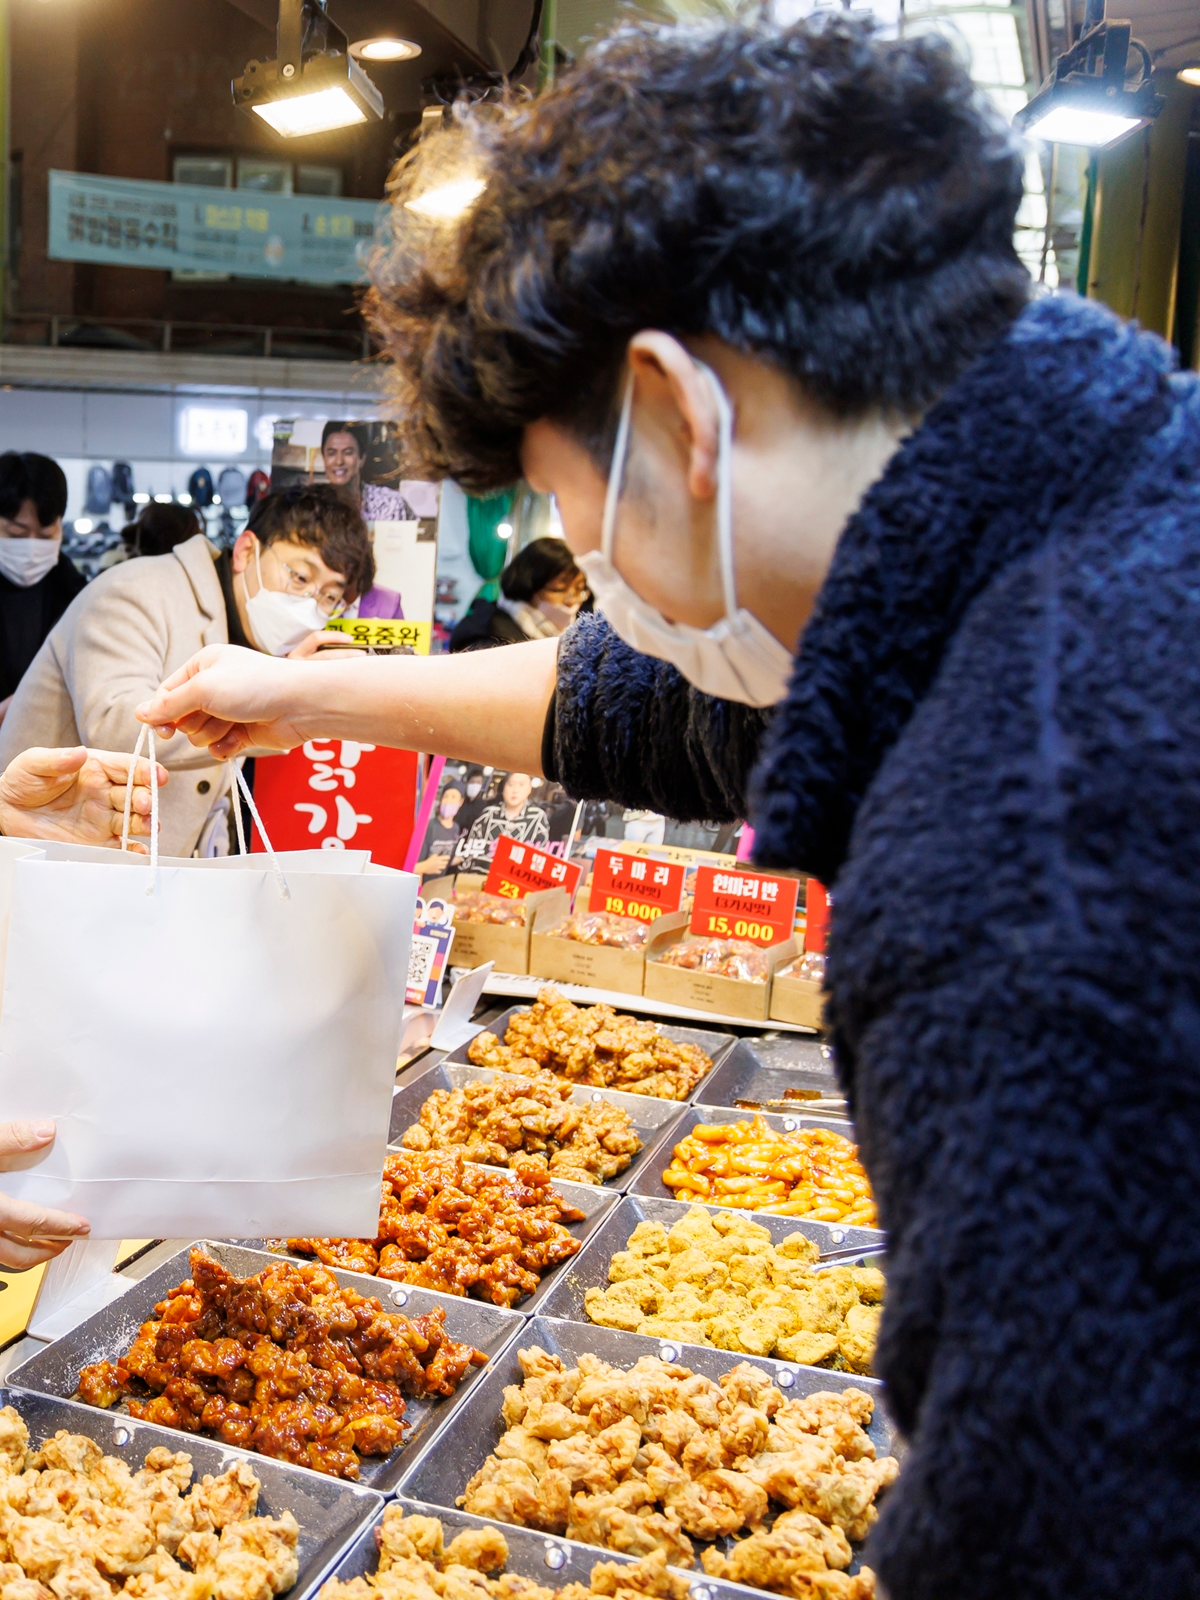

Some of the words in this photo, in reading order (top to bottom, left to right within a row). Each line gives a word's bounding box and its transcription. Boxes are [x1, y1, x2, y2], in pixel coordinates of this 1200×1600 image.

[455, 838, 487, 858] 너무
[712, 873, 759, 900] 한마리
[604, 896, 663, 921] 19,000
[707, 915, 774, 941] 15,000
